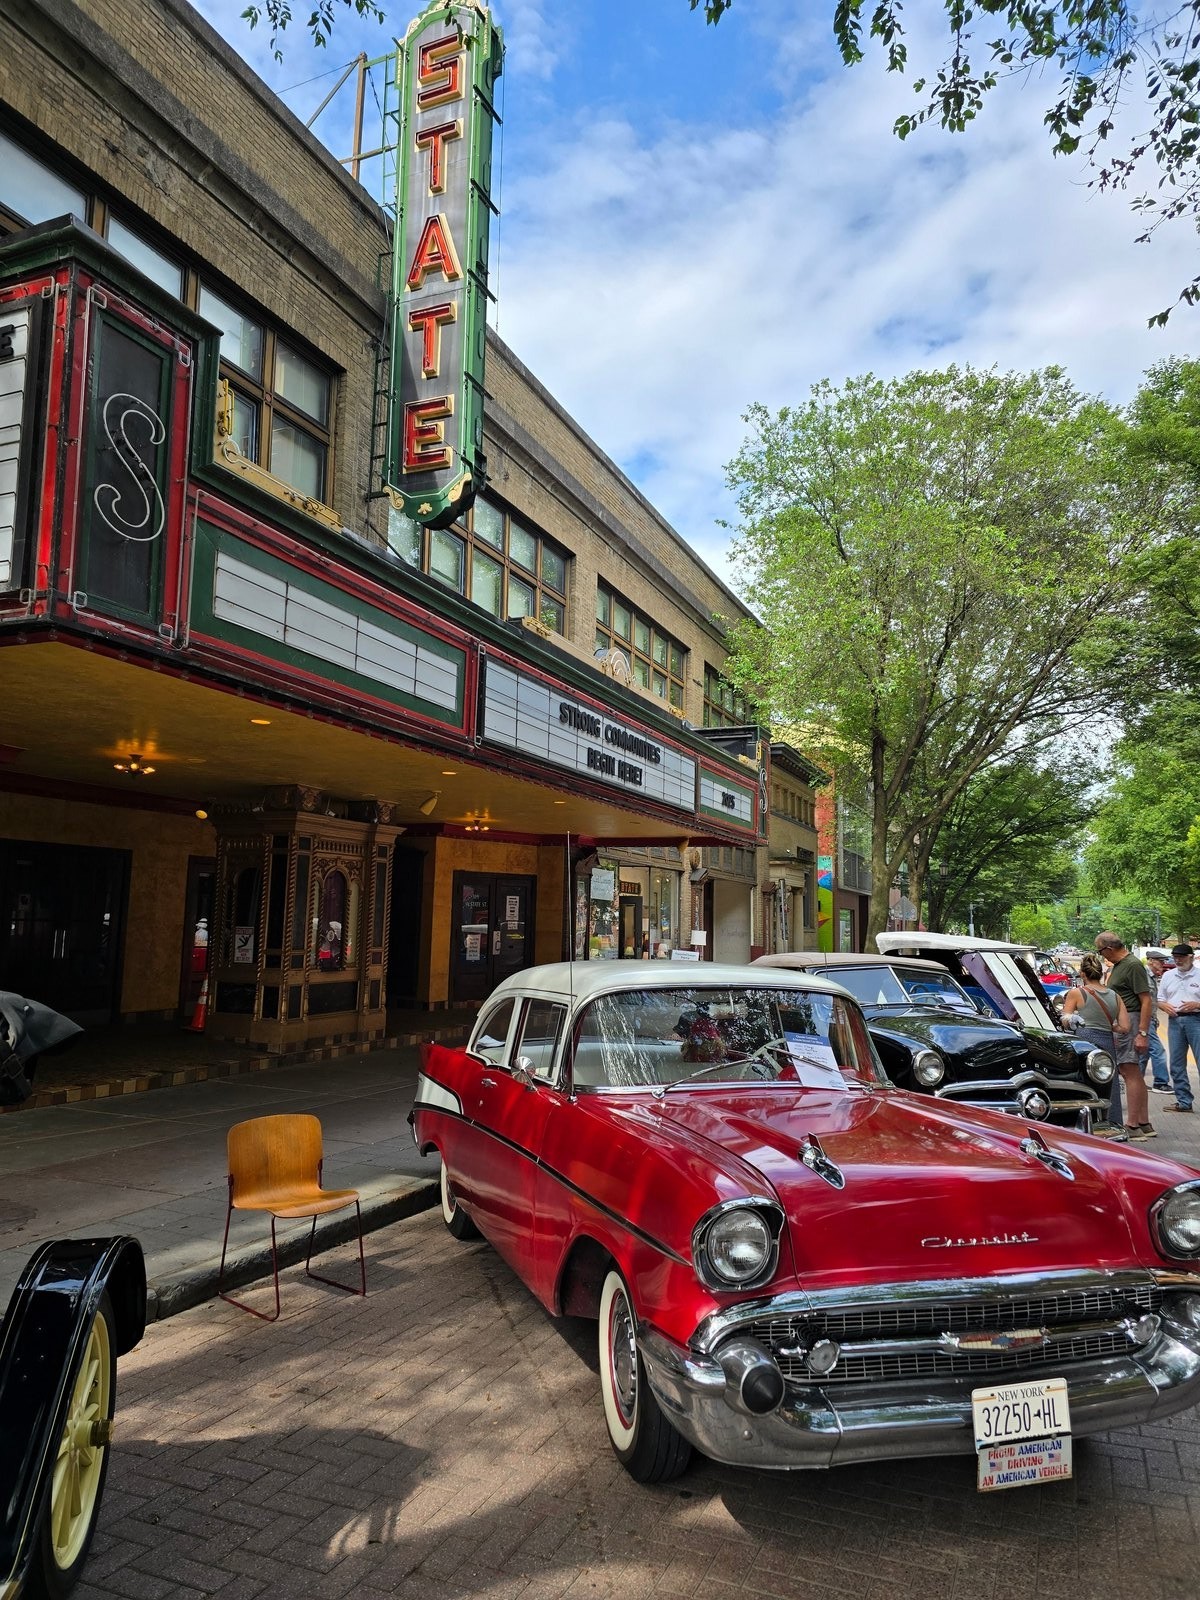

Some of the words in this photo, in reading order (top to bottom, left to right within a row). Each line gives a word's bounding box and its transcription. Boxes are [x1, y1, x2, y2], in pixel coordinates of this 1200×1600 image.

[402, 33, 467, 475] STATE
[559, 702, 601, 738] STRONG
[604, 724, 661, 764] COMMUNITIES
[587, 747, 616, 776] BEGIN
[617, 759, 643, 787] HERE!
[1007, 1063, 1048, 1073] FORD
[920, 1232, 1039, 1248] Chevrolet
[997, 1390, 1019, 1402] NEW
[1020, 1386, 1045, 1399] YORK
[982, 1402, 1031, 1438] 32250
[988, 1447, 1016, 1461] PROUD
[1017, 1439, 1062, 1456] AMERICAN
[1007, 1455, 1044, 1470] DRIVING
[982, 1475, 994, 1487] AN
[995, 1468, 1037, 1485] AMERICAN
[1038, 1464, 1069, 1478] VEHICLE
